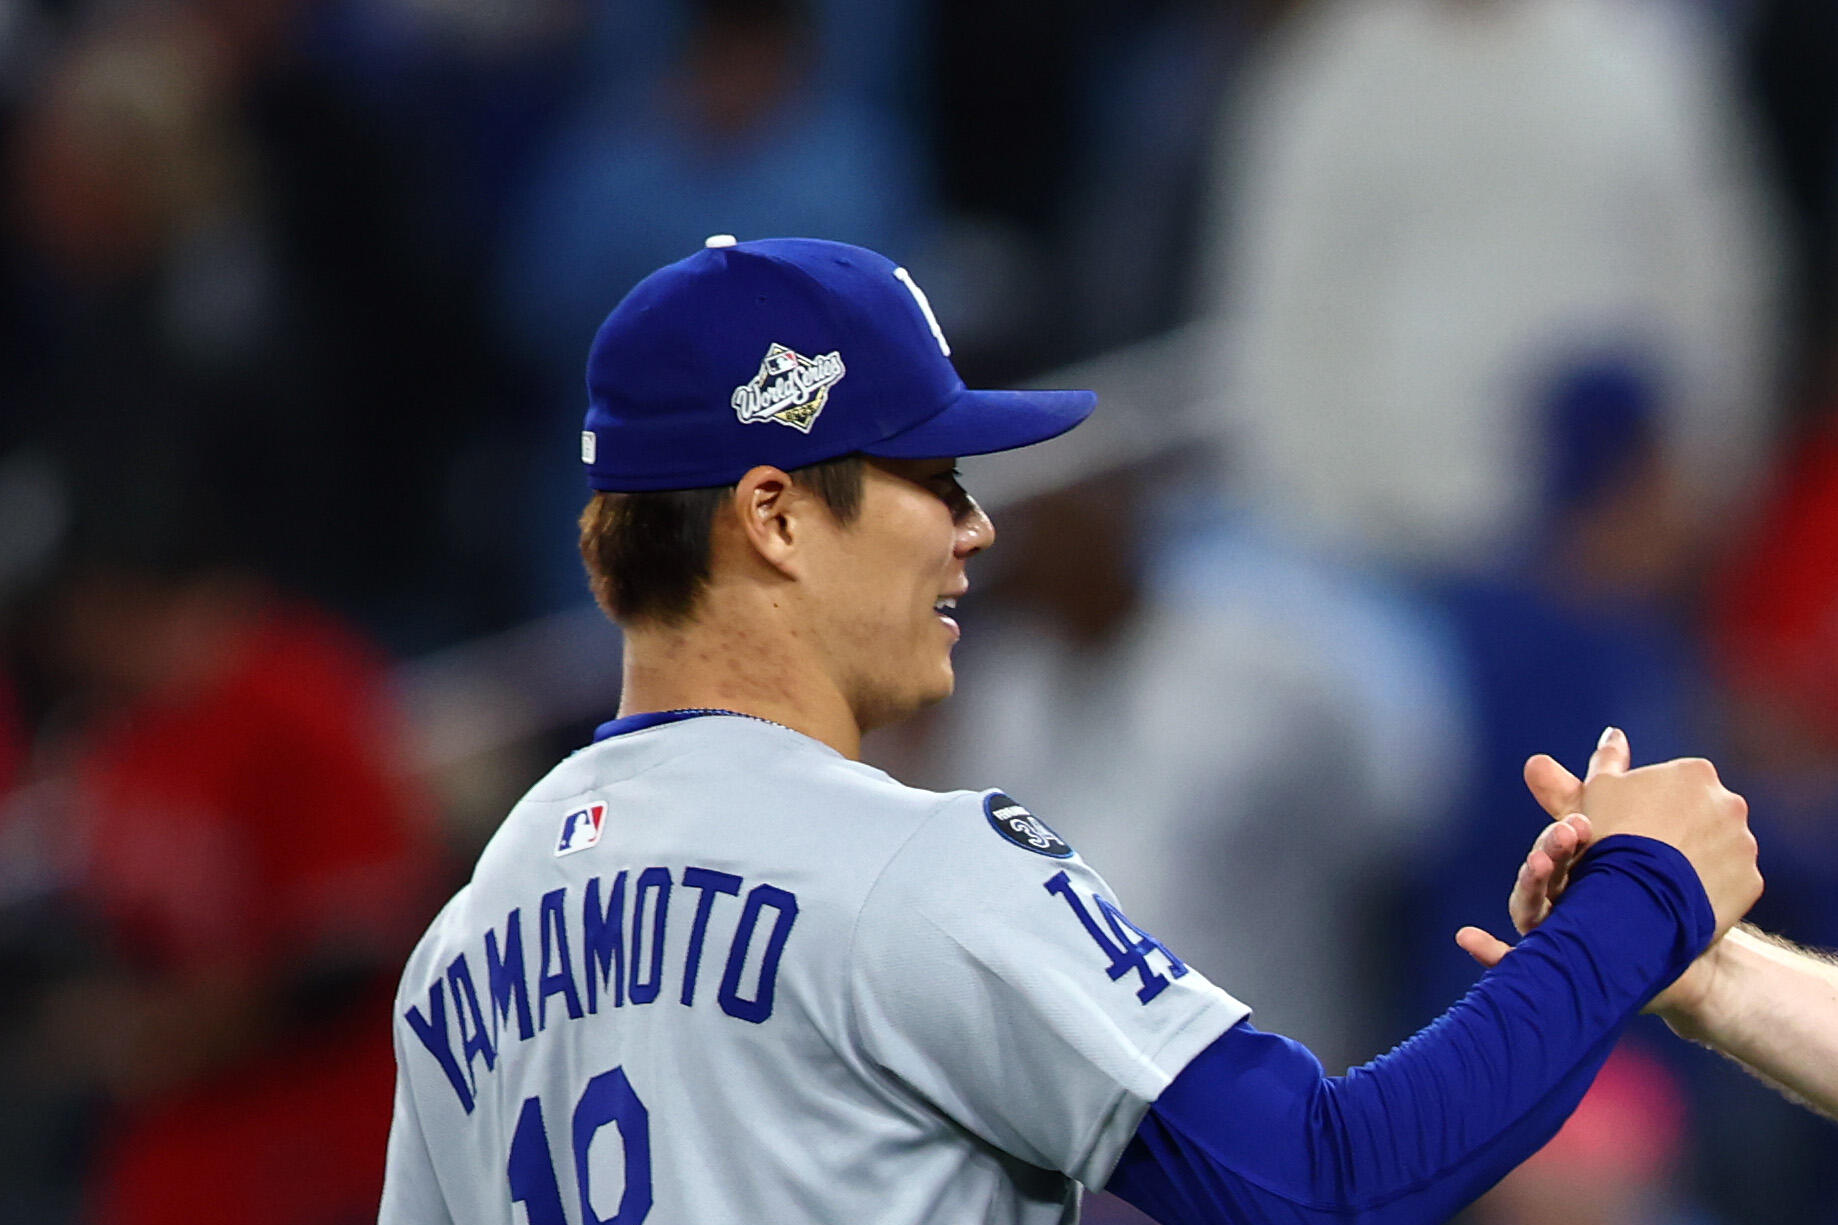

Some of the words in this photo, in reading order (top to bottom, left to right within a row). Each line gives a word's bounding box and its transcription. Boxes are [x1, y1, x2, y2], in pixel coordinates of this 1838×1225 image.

[736, 371, 797, 419] World
[791, 356, 842, 405] Series
[404, 866, 799, 1115] YAMAMOTO
[1043, 870, 1189, 1006] LA
